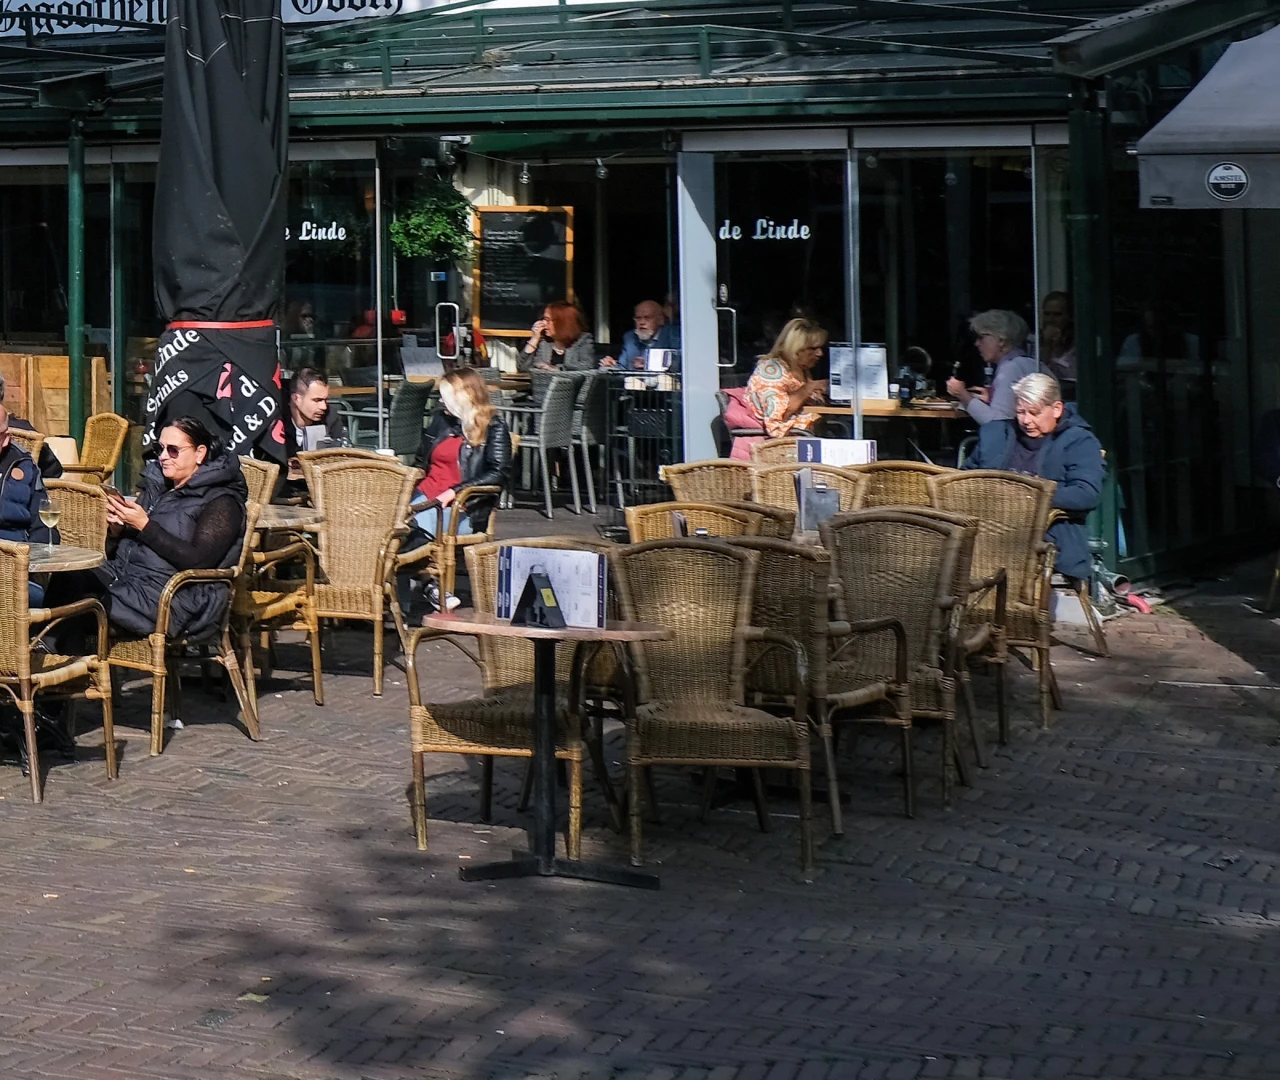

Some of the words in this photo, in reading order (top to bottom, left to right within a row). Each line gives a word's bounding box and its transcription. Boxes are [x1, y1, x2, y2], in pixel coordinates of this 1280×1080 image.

[1212, 174, 1244, 182] AMSTEL
[298, 221, 347, 240] Linde
[718, 219, 742, 240] de
[751, 218, 812, 240] Linde
